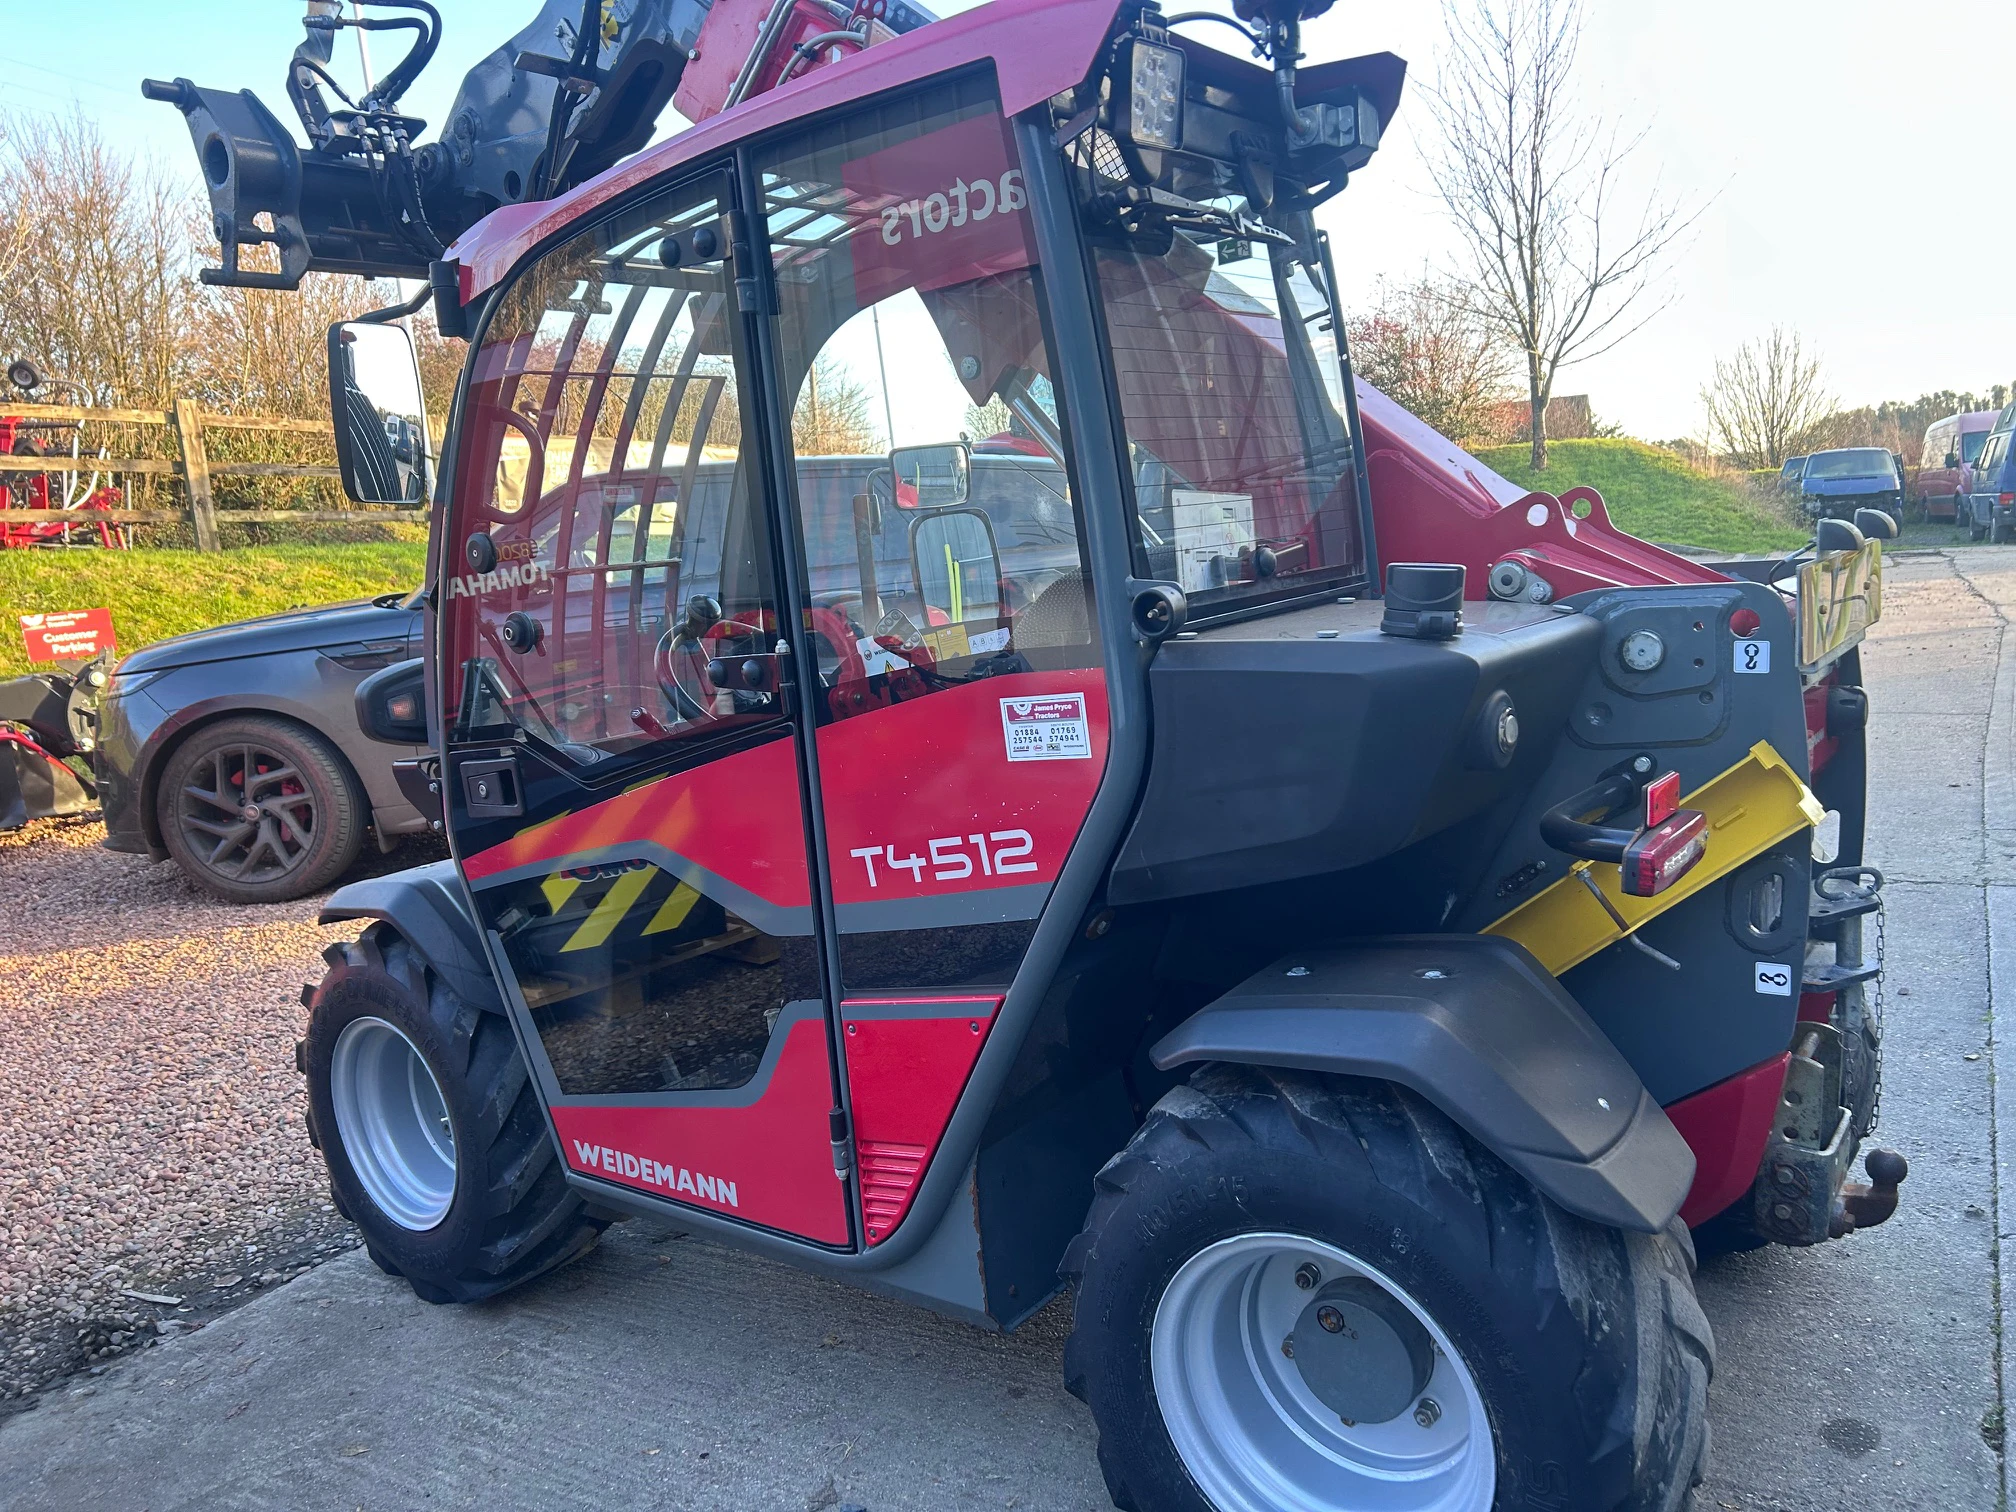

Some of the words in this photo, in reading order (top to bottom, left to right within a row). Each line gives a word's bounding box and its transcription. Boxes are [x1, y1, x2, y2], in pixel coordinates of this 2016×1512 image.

[42, 630, 98, 643] Customer
[51, 641, 96, 655] Parking
[1033, 704, 1053, 712] James
[1054, 703, 1072, 712] Pryce
[1014, 728, 1039, 736] 01884
[1050, 726, 1076, 734] 01769
[1013, 736, 1043, 744] 257544
[1049, 734, 1079, 742] 574941
[850, 828, 1038, 887] T4512
[573, 1139, 739, 1208] WEIDEMANN
